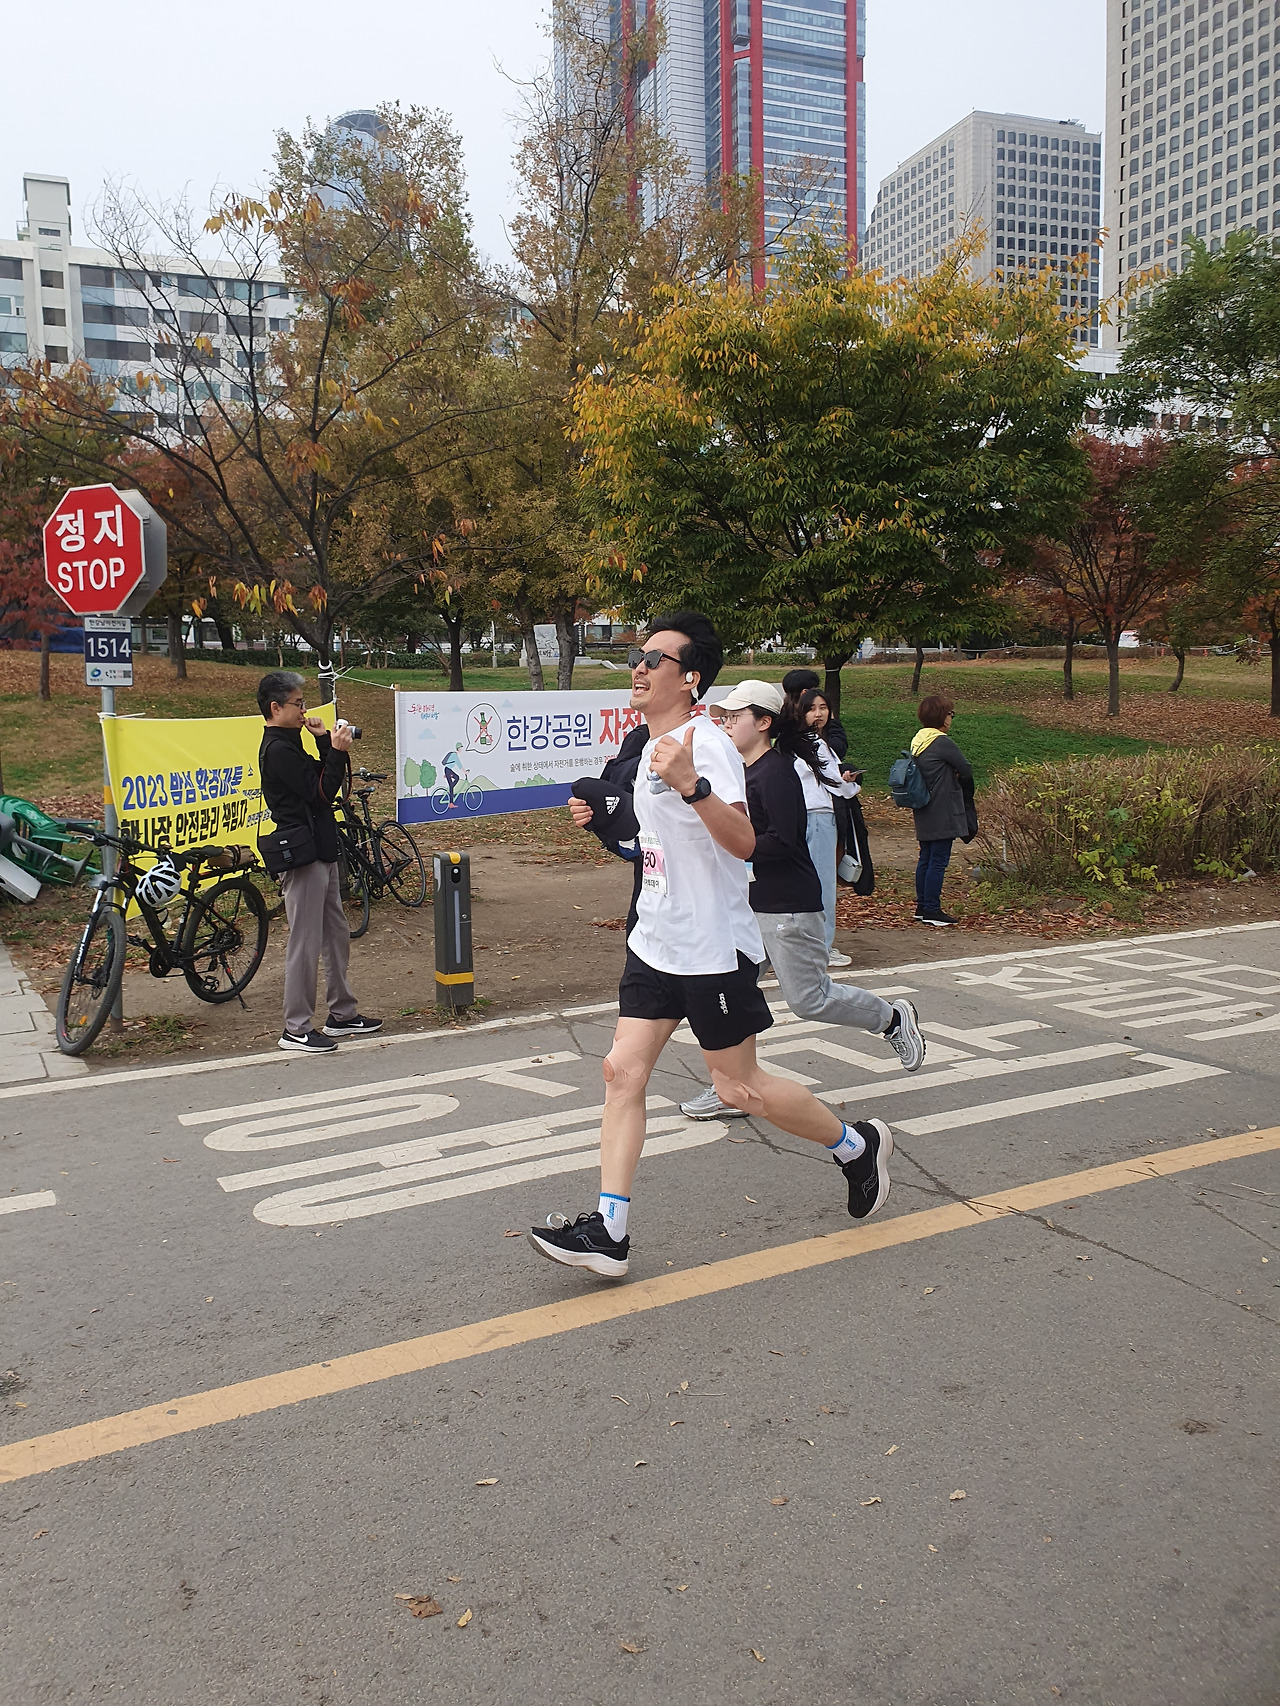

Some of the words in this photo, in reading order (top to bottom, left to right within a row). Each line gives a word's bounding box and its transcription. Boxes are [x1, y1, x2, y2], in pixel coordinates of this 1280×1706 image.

[55, 504, 124, 552] 정지
[57, 557, 125, 593] STOP
[87, 637, 131, 658] 1514
[506, 713, 592, 751] 한강공원
[599, 708, 642, 745] 자전
[122, 774, 168, 810] 2023
[169, 771, 197, 806] 밤섬
[175, 806, 220, 847] 안전관리
[222, 799, 248, 833] 책임자
[718, 992, 729, 1015] adidas
